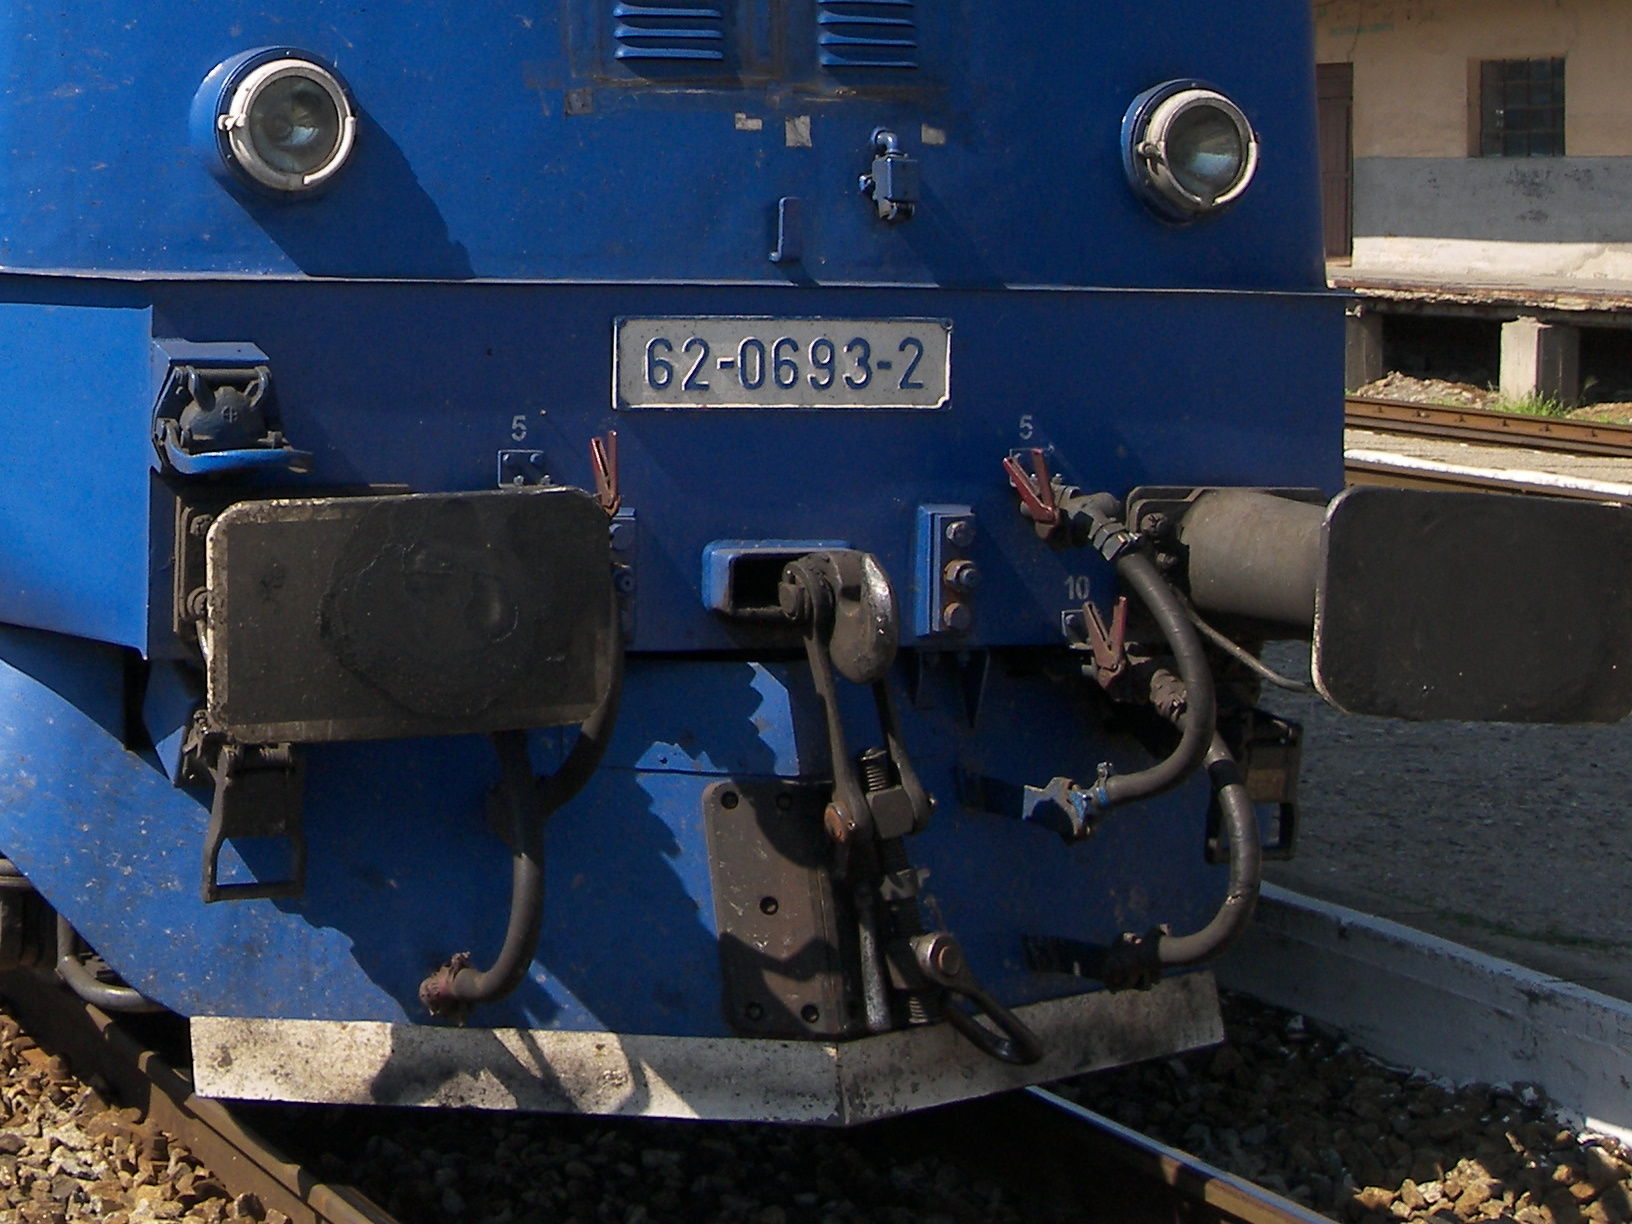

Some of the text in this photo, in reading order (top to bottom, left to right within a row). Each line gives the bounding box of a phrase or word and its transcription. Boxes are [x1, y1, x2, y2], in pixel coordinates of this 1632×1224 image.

[644, 336, 924, 390] 62-0693-2
[511, 414, 528, 442] 5
[1019, 414, 1034, 440] 5
[1064, 575, 1091, 600] 10
